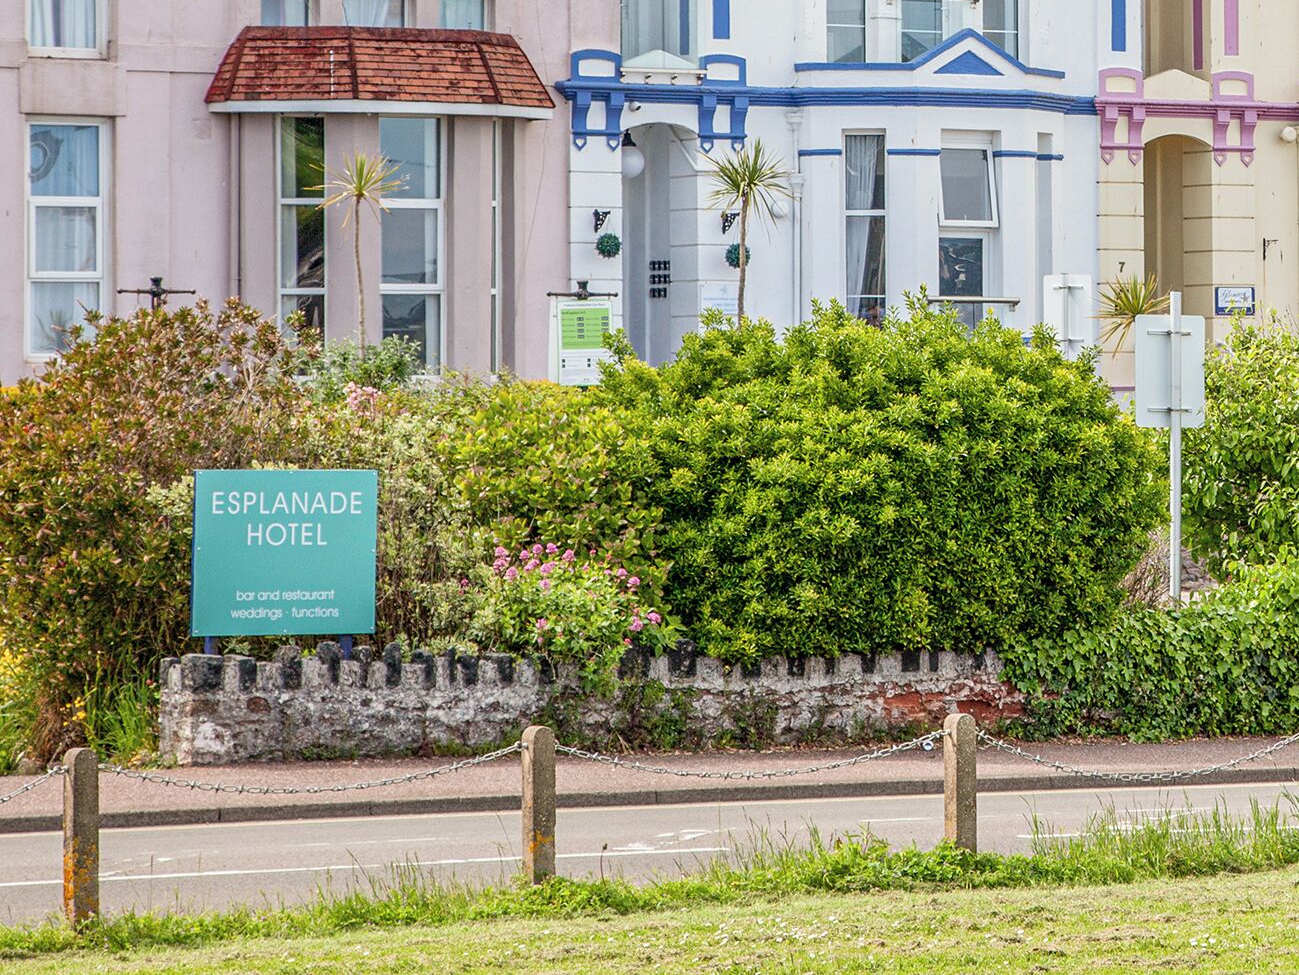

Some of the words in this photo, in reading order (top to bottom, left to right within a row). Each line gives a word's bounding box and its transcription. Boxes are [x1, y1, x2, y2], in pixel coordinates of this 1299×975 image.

[1118, 261, 1126, 273] 7
[211, 491, 363, 515] ESPLANADE
[247, 522, 328, 547] HOTEL
[235, 589, 254, 601] bar
[257, 589, 280, 601] and
[281, 589, 335, 601] restaurant
[230, 607, 283, 621] weddings
[291, 606, 340, 618] functions
